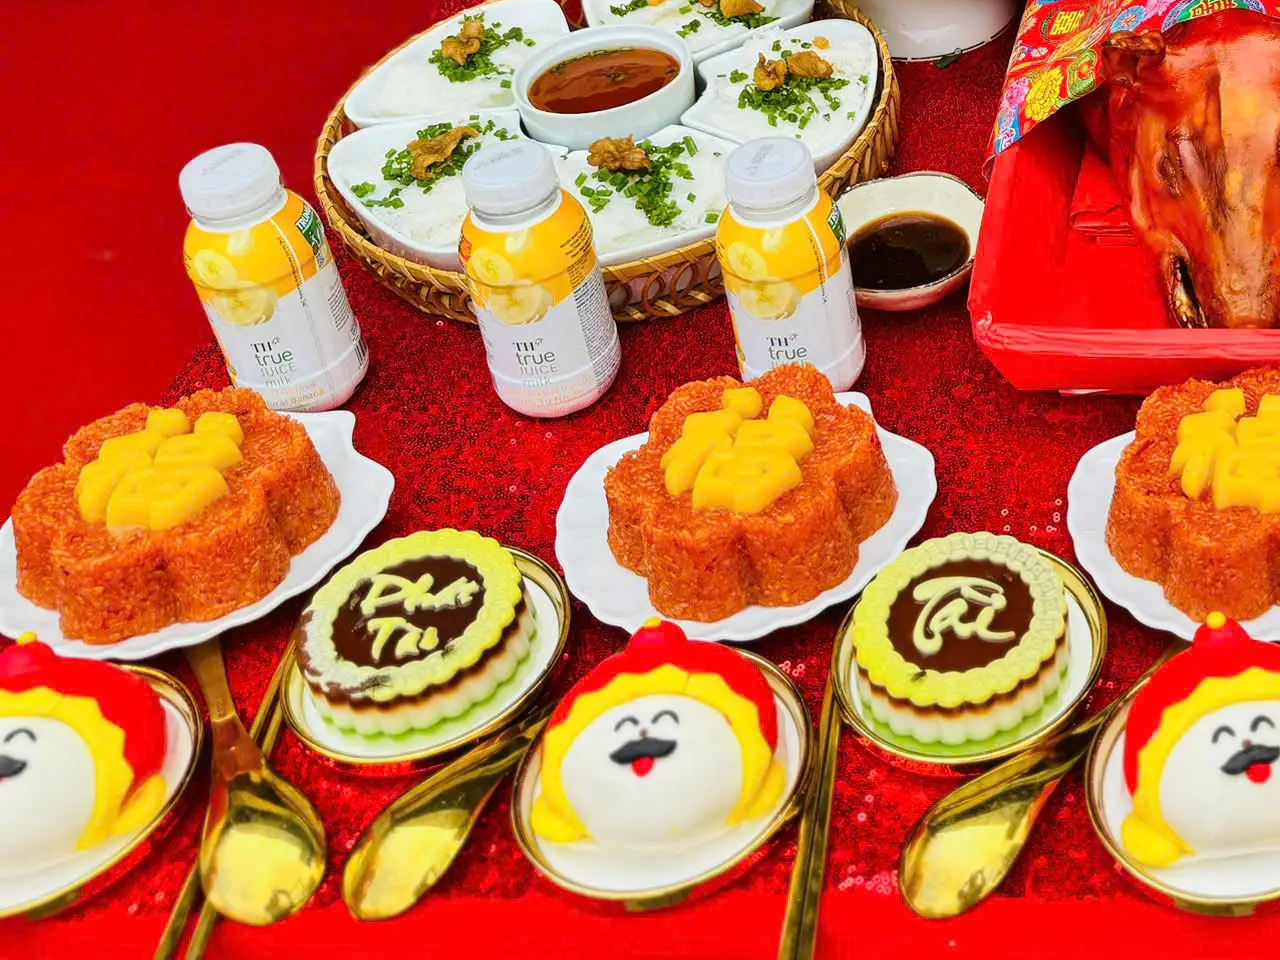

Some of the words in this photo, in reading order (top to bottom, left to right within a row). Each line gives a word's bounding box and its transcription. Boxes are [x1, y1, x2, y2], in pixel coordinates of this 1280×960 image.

[255, 351, 293, 366] true
[516, 352, 556, 365] true
[768, 347, 807, 360] true
[261, 362, 297, 377] JUICE
[520, 363, 558, 376] JUICE
[266, 376, 292, 389] milk
